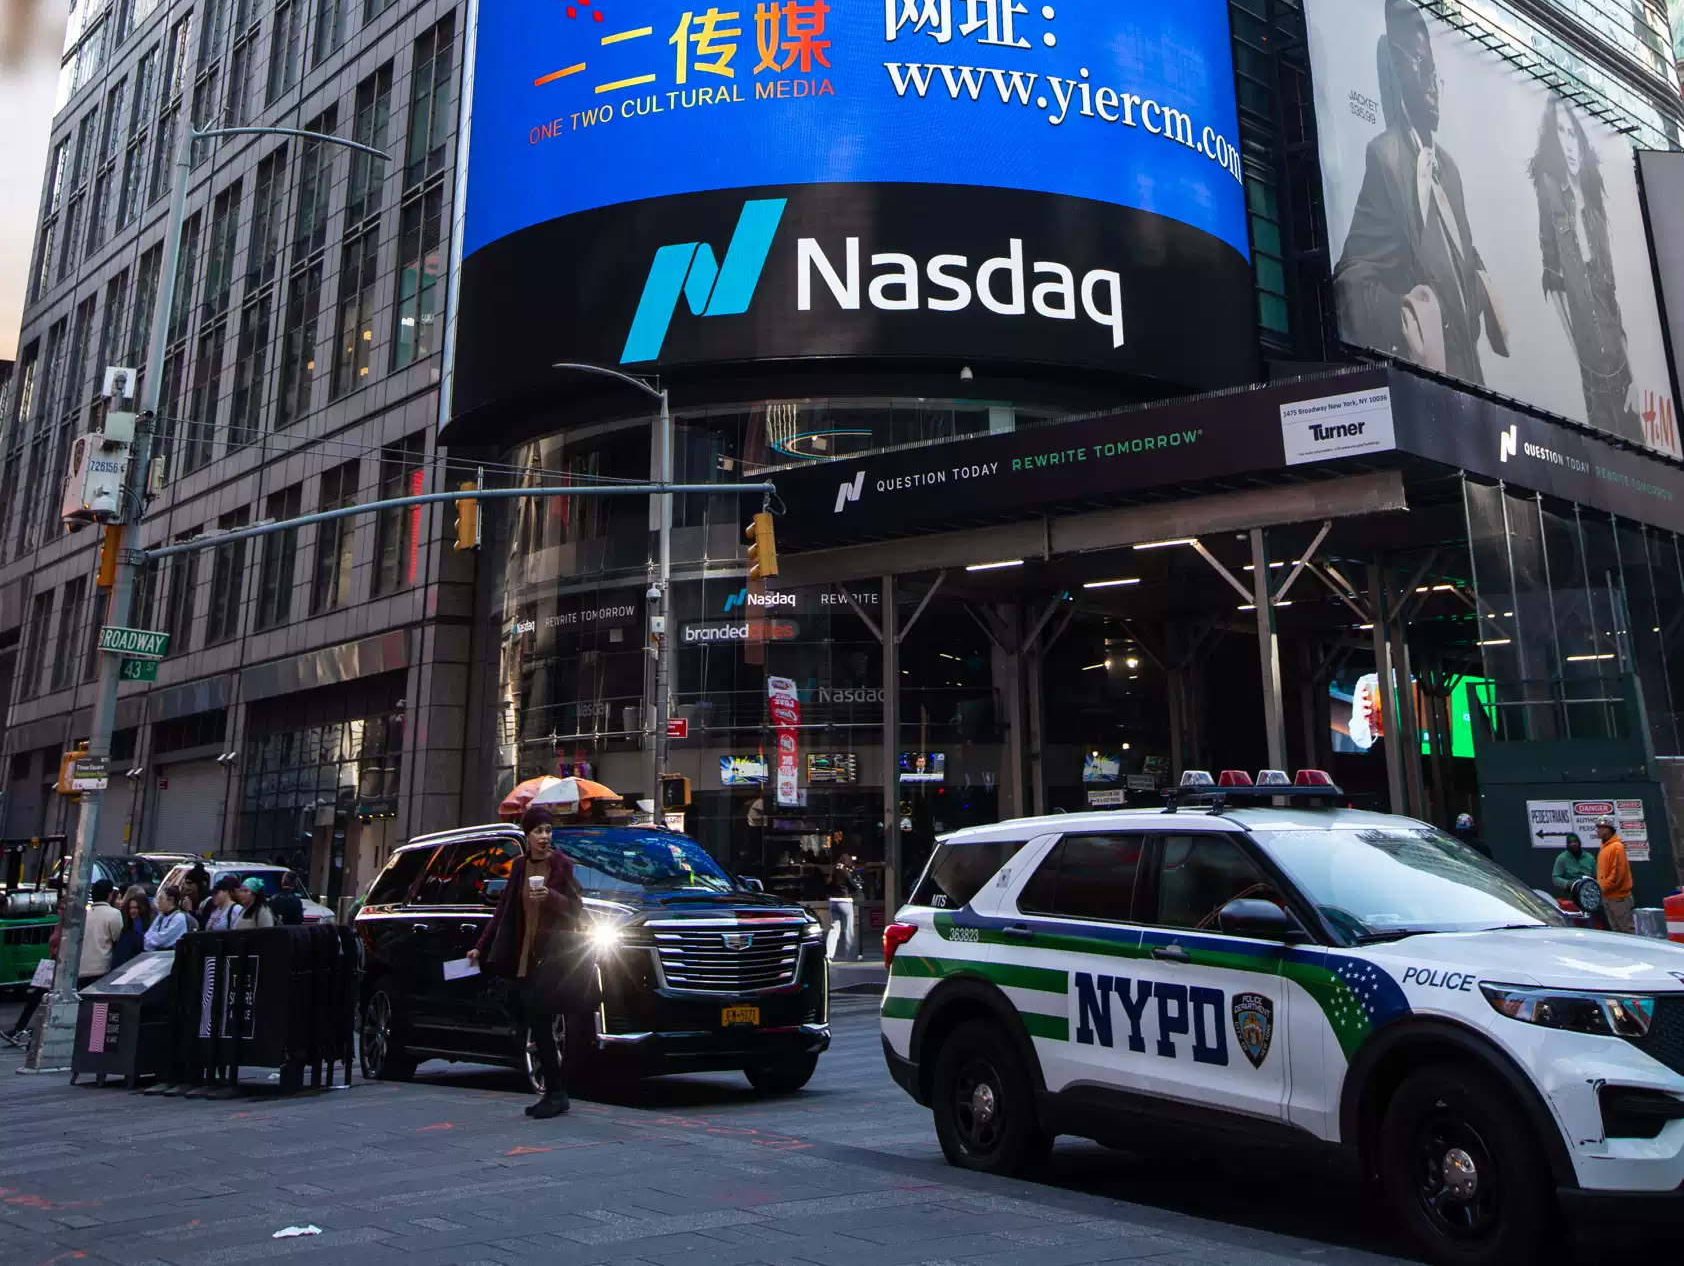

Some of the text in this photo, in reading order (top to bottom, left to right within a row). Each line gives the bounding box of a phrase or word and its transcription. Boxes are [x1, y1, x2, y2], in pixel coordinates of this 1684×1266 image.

[534, 0, 831, 94] 一二传媒
[529, 78, 836, 146] ONE TWO CULTURAL MEDIA
[1347, 89, 1379, 113] JACKET
[884, 61, 1244, 186] www.yiercm.com
[797, 236, 1125, 349] Nasdaq
[1283, 409, 1297, 417] 1475
[1298, 403, 1328, 415] Broadway
[1328, 403, 1342, 411] New
[1342, 400, 1359, 408] York,
[1369, 394, 1388, 403] 10036
[1308, 421, 1366, 442] Turner
[1641, 389, 1676, 455] H&M
[90, 460, 120, 474] 726156
[1523, 442, 1564, 466] QUESTION
[1566, 456, 1590, 474] TODAY
[876, 470, 947, 493] QUESTION
[952, 462, 999, 481] TODAY
[1011, 448, 1087, 471] REWRITE
[747, 592, 796, 607] Nasdaq
[517, 606, 636, 634] Nasdaq REWRITE TOMORROW
[99, 628, 166, 654] BROADWAY
[123, 659, 142, 680] 43
[1530, 809, 1570, 825] PEDESTRIANS
[1578, 804, 1609, 813] DANGER
[931, 893, 947, 908] MTS
[949, 927, 980, 942] 363823
[1402, 966, 1477, 993] POLICE
[1234, 1002, 1271, 1018] DEPARTMENT
[1242, 995, 1263, 1005] POLICE
[1074, 971, 1230, 1067] NYPD
